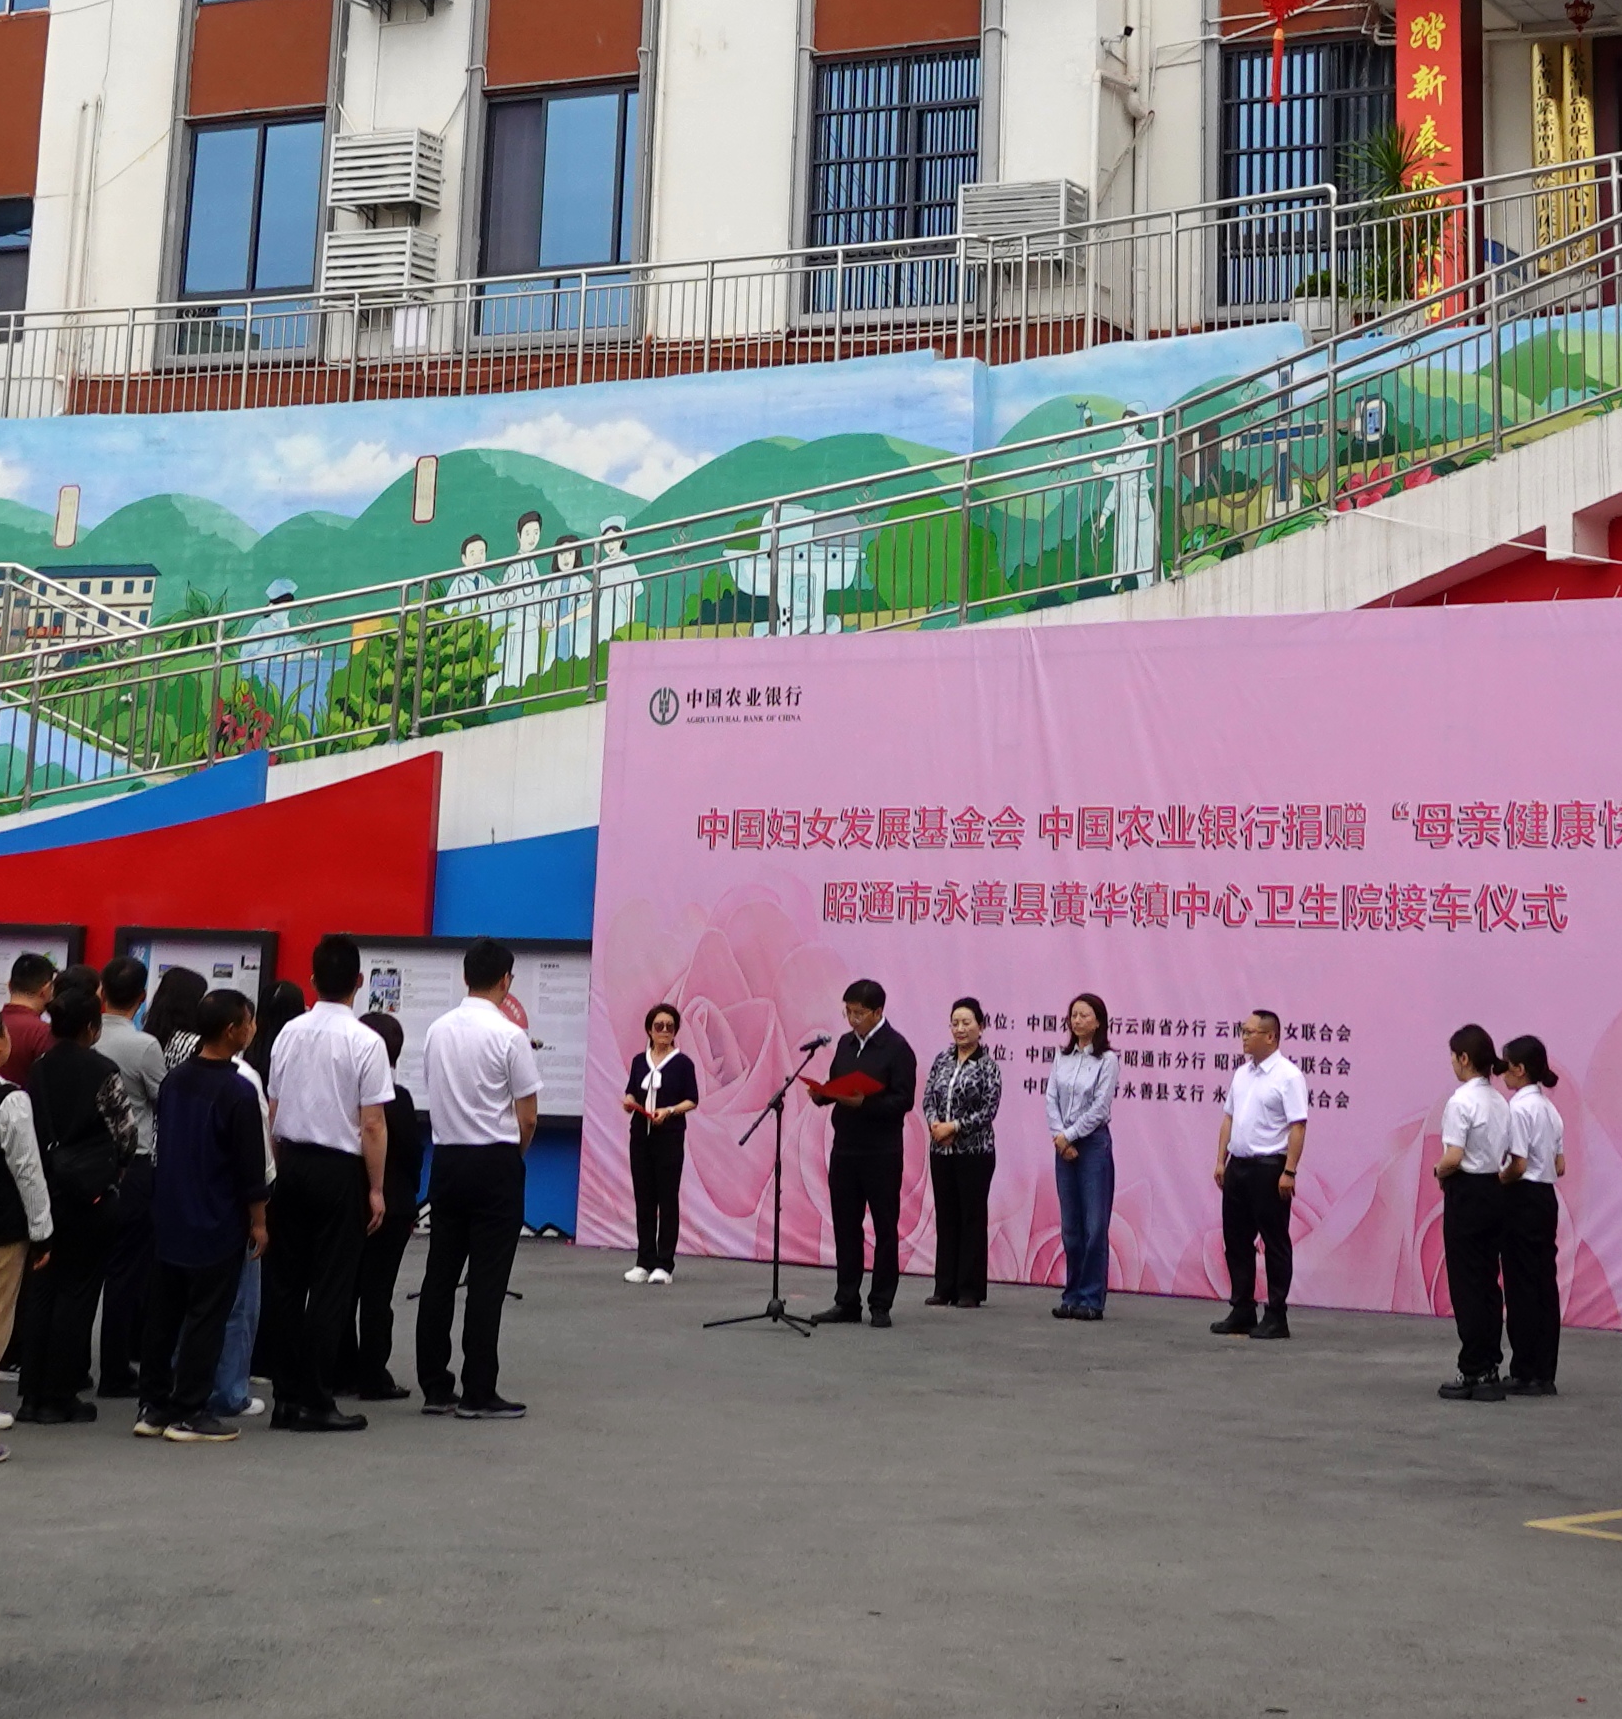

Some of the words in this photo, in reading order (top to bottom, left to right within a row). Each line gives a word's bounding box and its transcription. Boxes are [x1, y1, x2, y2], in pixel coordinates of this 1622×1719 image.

[686, 685, 803, 709] 中国农业银行
[743, 714, 763, 723] BANK
[766, 714, 776, 722] OF
[778, 714, 802, 722] CHINA
[697, 805, 1027, 851] 中国妇女发展基金会
[1040, 801, 1368, 851] 中国农业银行捐赠
[822, 880, 1569, 933] 昭通市永善县黄华镇中心卫生院接车仪式
